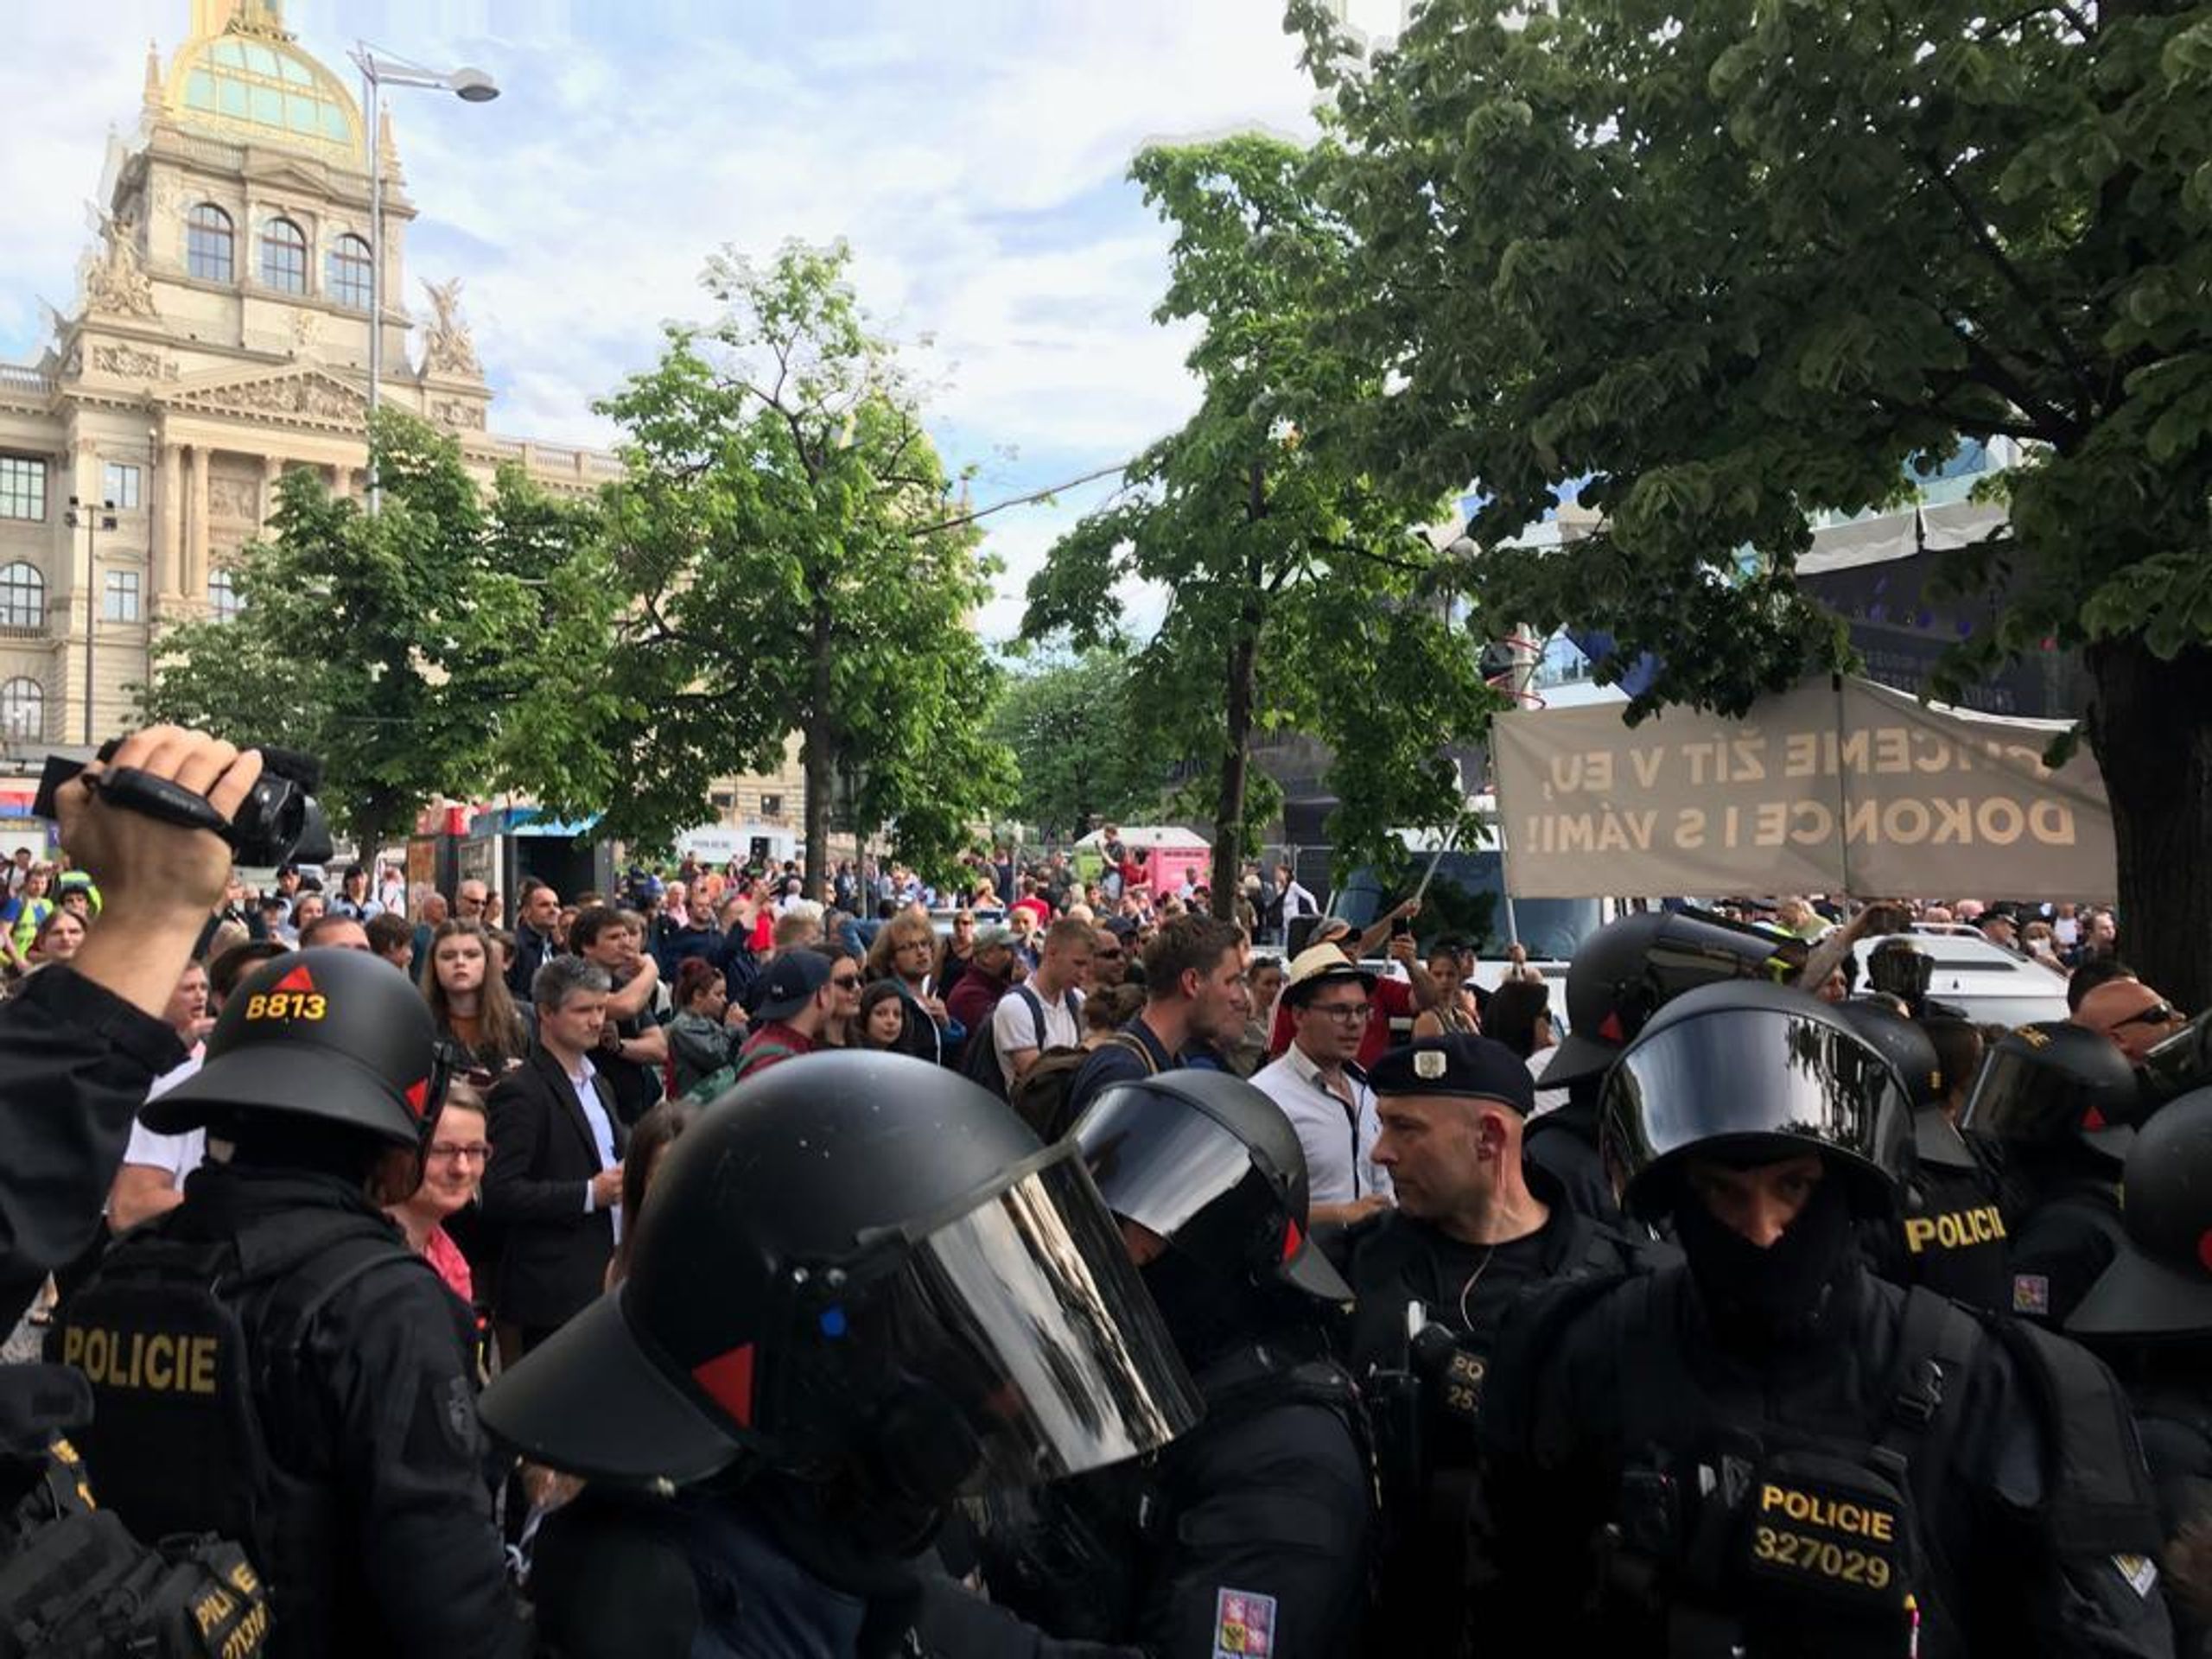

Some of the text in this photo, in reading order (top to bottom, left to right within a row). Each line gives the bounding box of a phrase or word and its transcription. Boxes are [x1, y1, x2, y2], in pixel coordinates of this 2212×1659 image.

[245, 994, 326, 1020] B813
[64, 1326, 217, 1393] POLICIE
[1762, 1484, 1894, 1541] POLICIE
[1753, 1526, 1891, 1589] 327029
